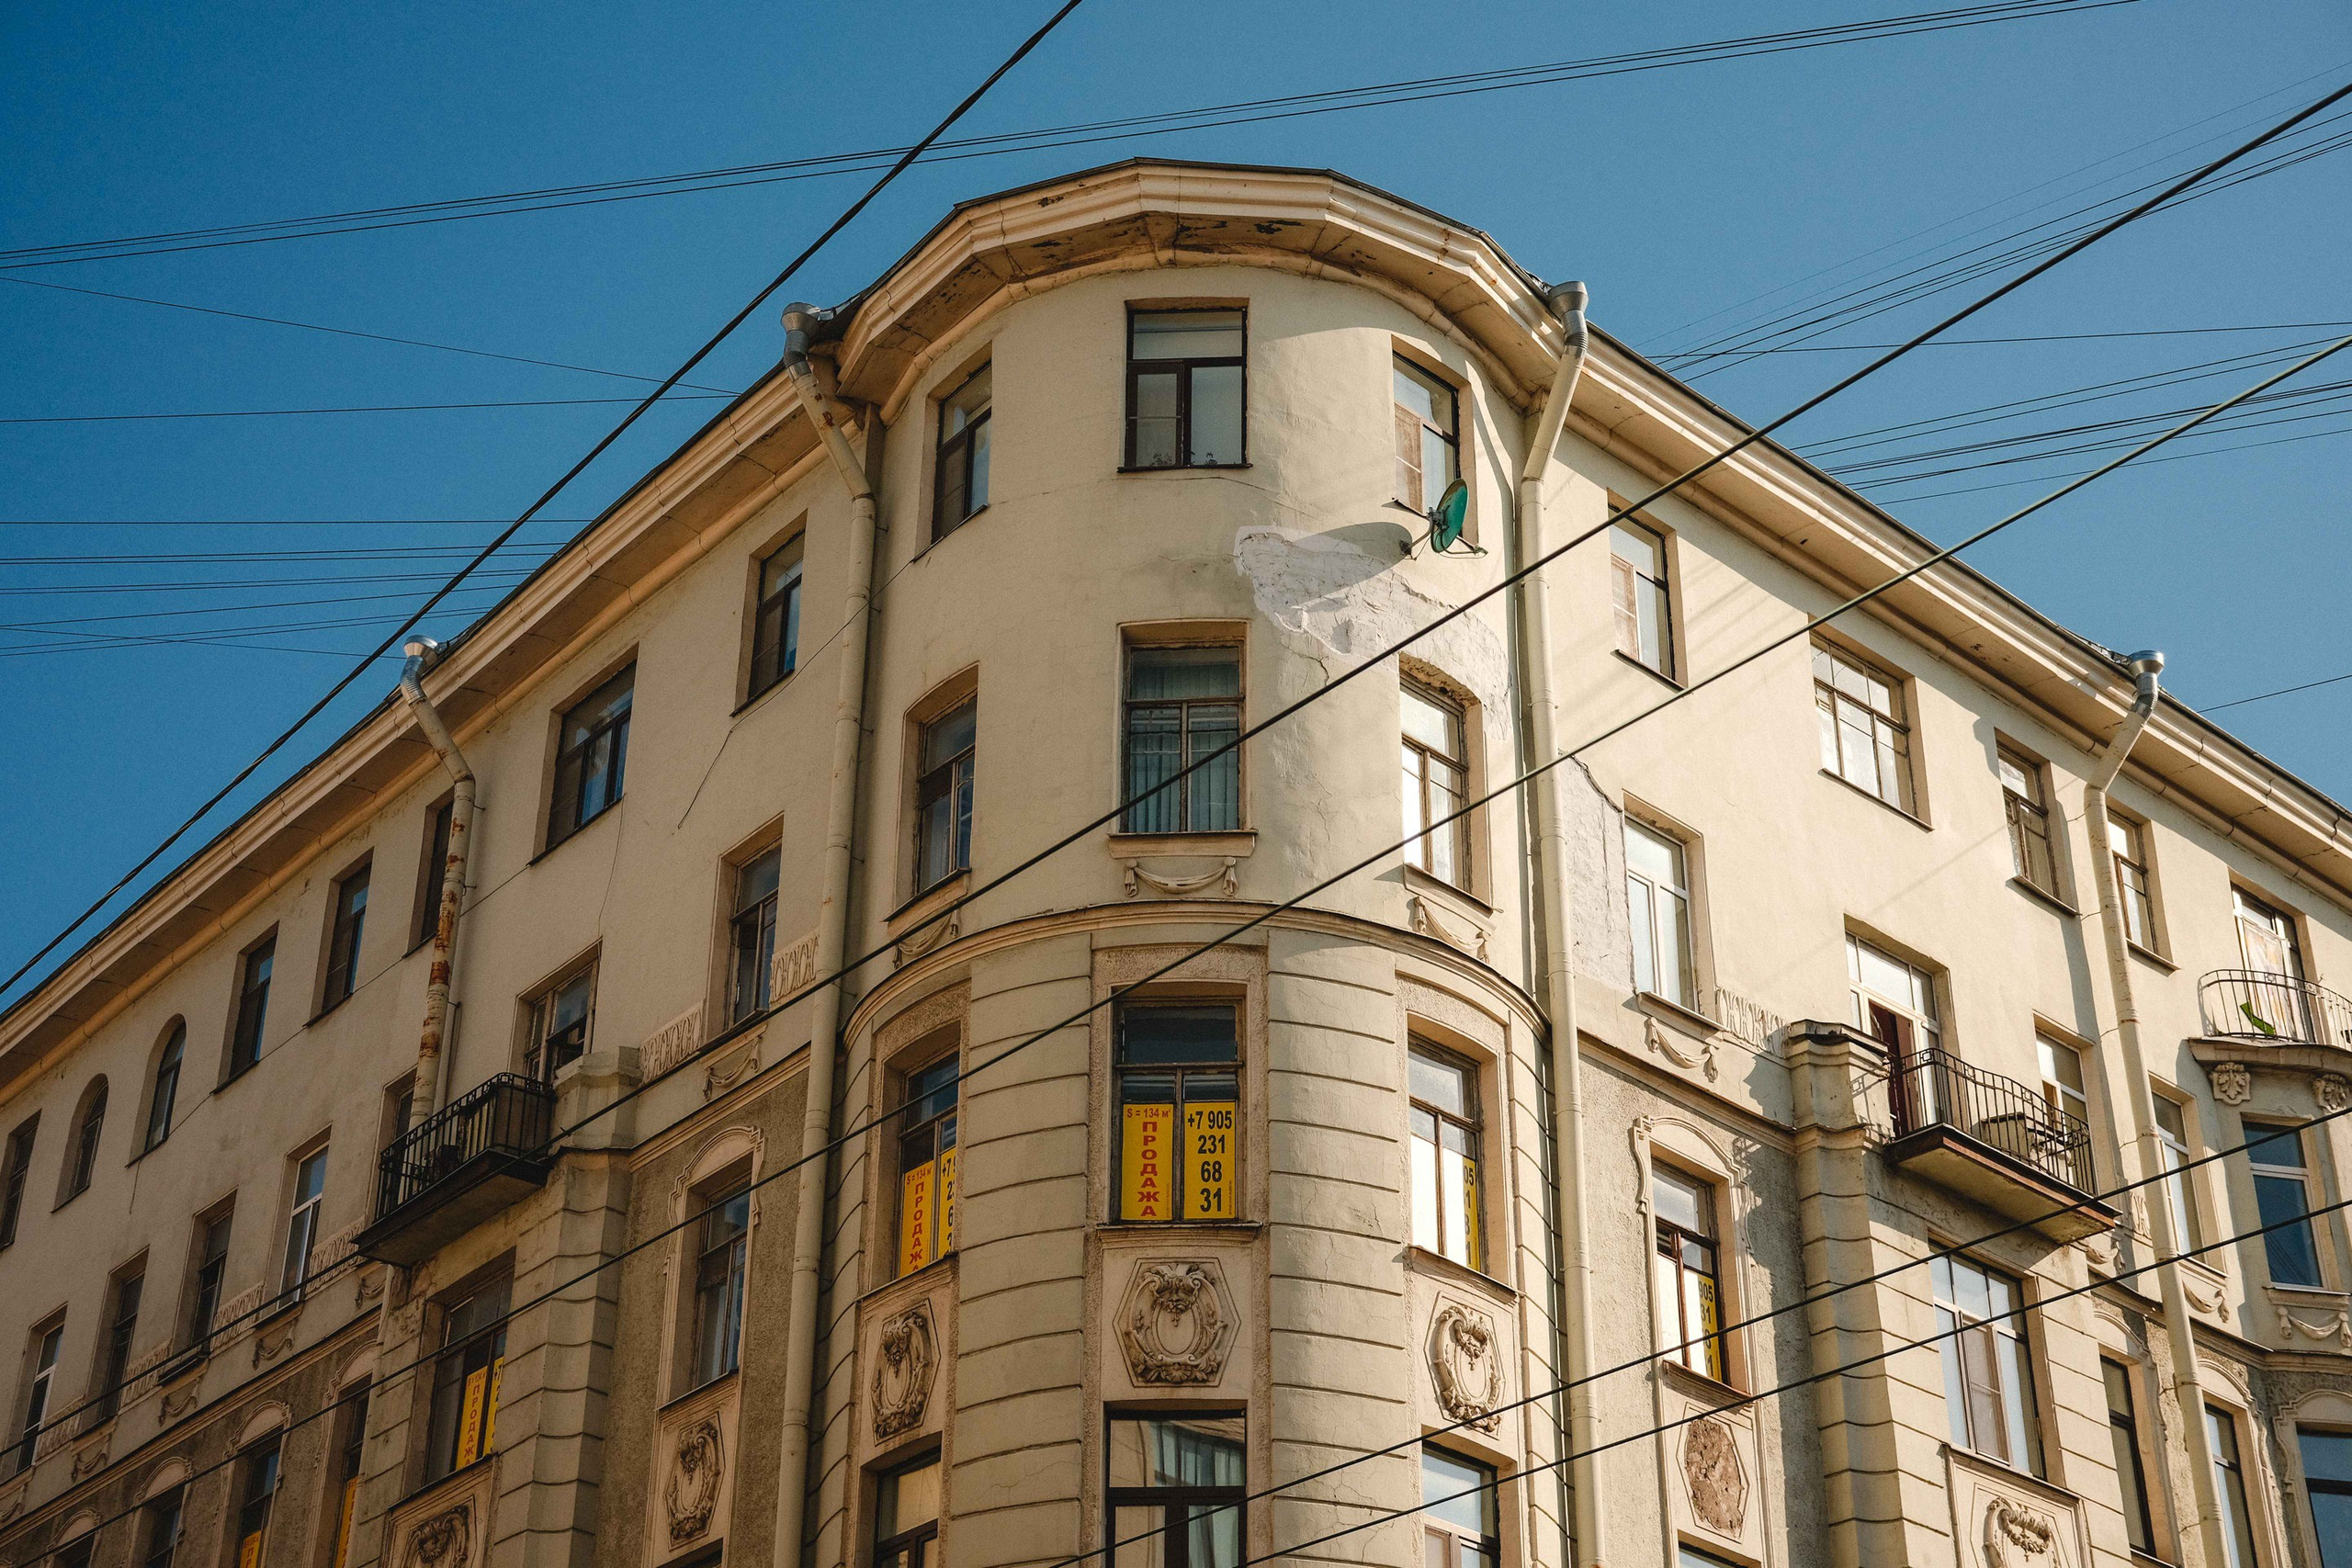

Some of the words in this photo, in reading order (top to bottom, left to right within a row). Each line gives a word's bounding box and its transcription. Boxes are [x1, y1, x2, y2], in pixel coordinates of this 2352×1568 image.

[1126, 1108, 1133, 1118] S
[1143, 1108, 1159, 1118] 134
[1188, 1111, 1204, 1130] +7
[1208, 1111, 1232, 1130] 905
[1197, 1134, 1226, 1155] 231
[1137, 1122, 1159, 1217] ПРОДАЖА
[1201, 1160, 1222, 1183] 68
[1200, 1188, 1222, 1213] 31
[1698, 1280, 1713, 1303] 905
